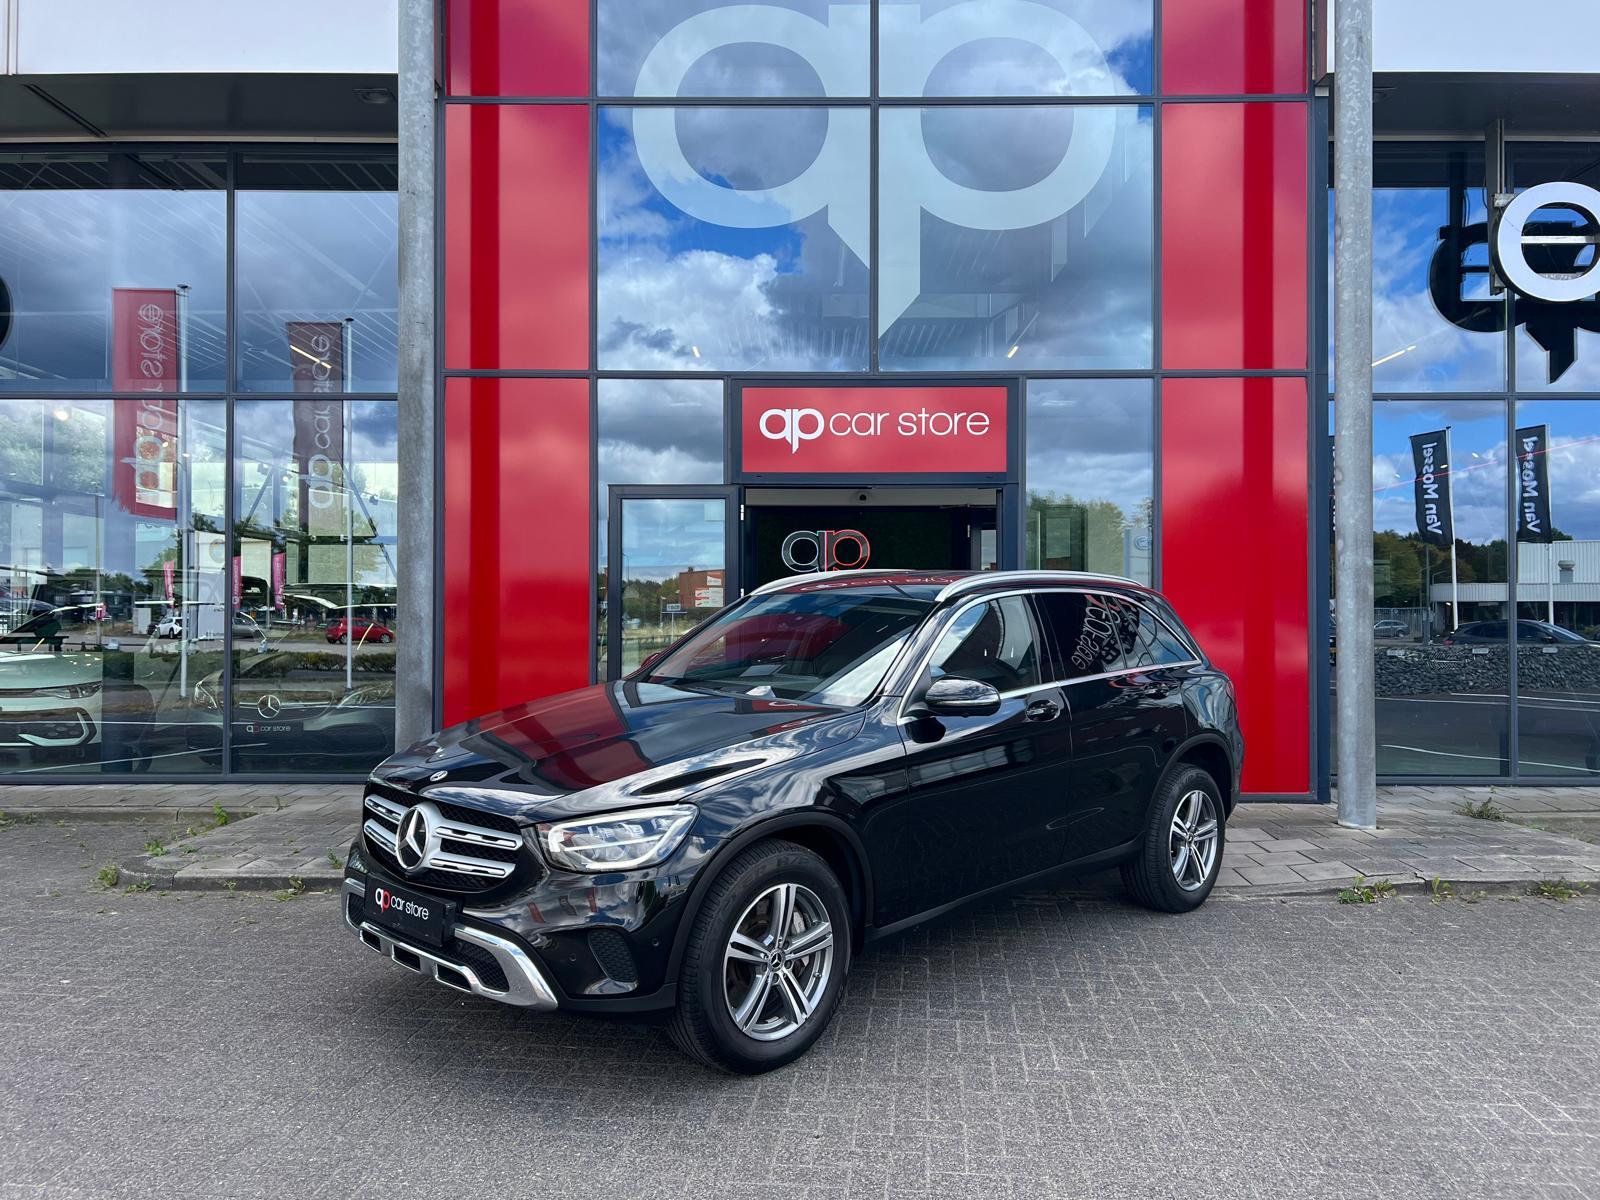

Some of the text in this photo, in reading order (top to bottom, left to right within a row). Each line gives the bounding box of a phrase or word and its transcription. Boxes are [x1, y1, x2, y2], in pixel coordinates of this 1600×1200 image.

[632, 0, 1116, 338] ap
[759, 407, 990, 454] ap car store
[375, 888, 429, 920] ap car store
